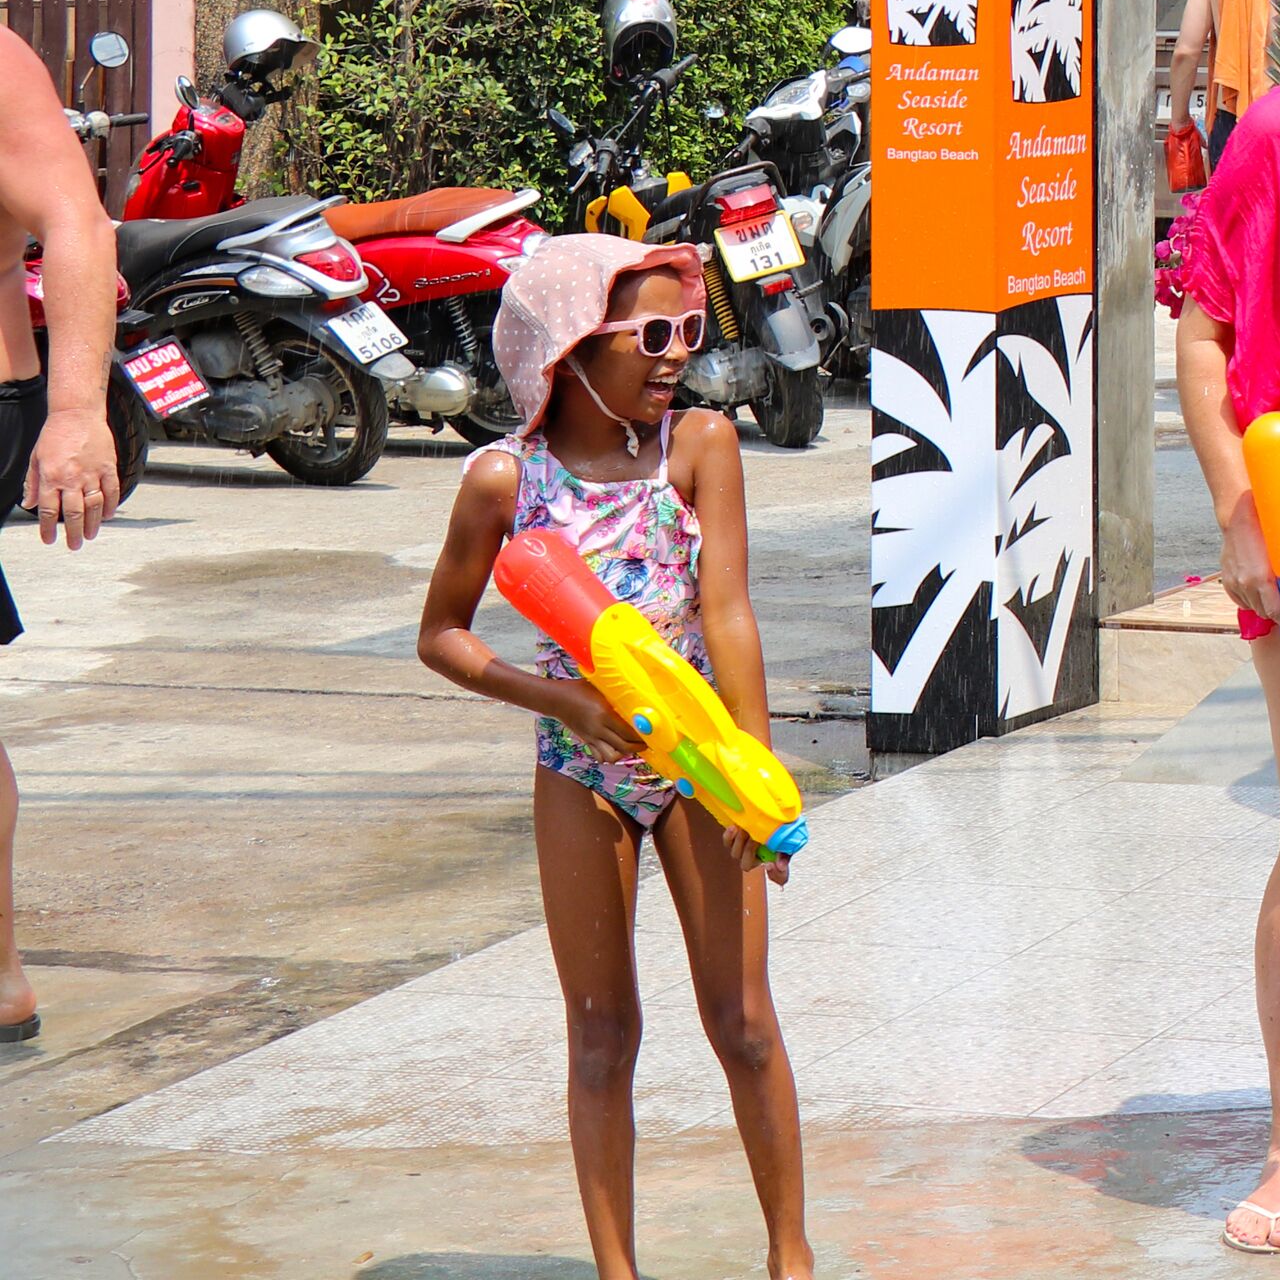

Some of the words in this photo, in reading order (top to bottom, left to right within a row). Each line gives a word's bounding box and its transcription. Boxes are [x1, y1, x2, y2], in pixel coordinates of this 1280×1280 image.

[886, 60, 980, 82] Andaman
[897, 90, 968, 110] Seaside
[902, 117, 963, 140] Resort
[887, 148, 937, 164] Bangtao
[940, 148, 979, 161] Beach
[1006, 129, 1088, 161] Andaman
[1016, 170, 1078, 209] Seaside
[1020, 218, 1073, 257] Resort
[750, 251, 784, 272] 131
[1007, 273, 1050, 295] Bangtao
[1053, 267, 1086, 287] Beach
[147, 344, 182, 368] 300
[358, 332, 402, 360] 5106
